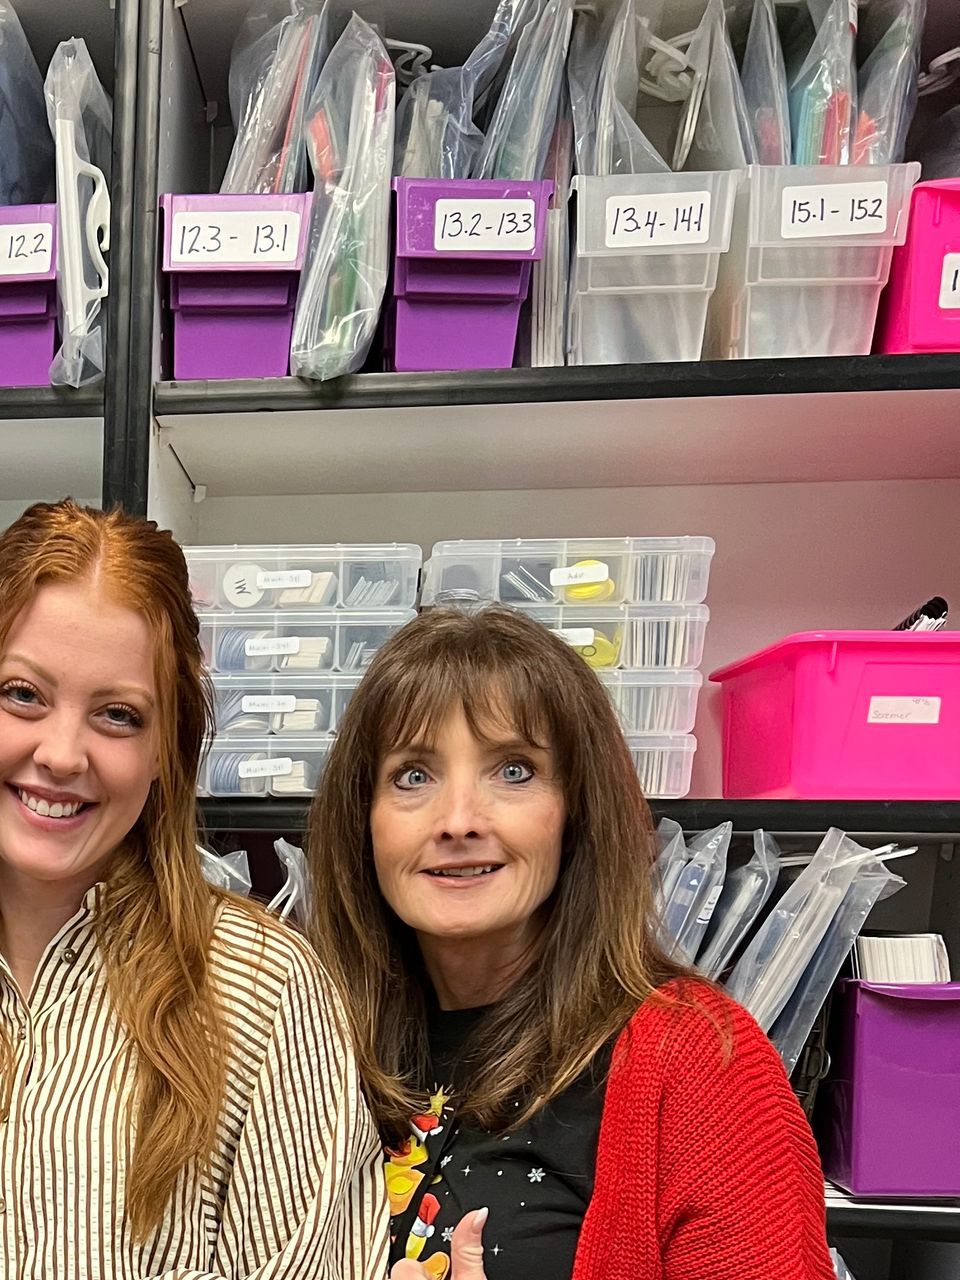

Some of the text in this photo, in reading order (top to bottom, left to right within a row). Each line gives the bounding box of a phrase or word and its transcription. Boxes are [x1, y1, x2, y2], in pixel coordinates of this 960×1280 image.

[791, 197, 824, 224] 15.1
[7, 232, 48, 260] 12.2
[179, 224, 222, 256] 12.3
[252, 223, 289, 254] 13.1
